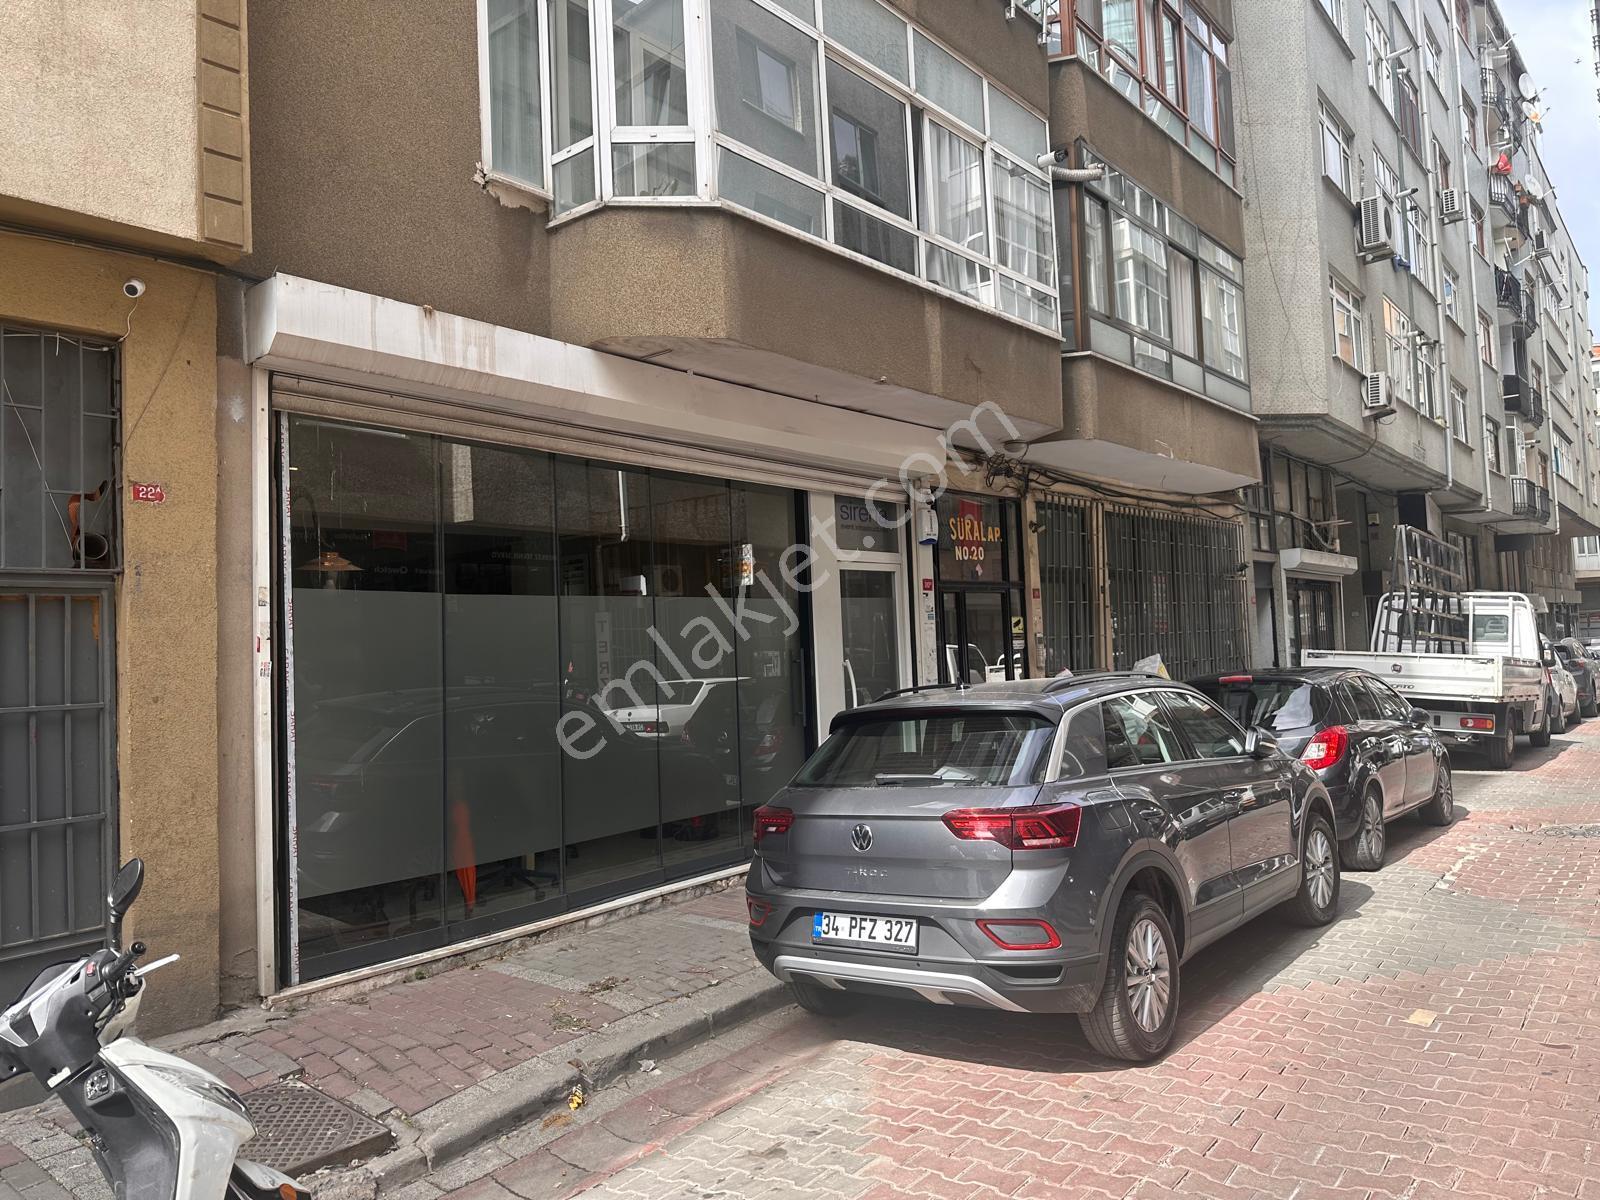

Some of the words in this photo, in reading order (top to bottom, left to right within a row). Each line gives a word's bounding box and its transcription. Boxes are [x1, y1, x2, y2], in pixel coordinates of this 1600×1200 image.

[954, 545, 985, 561] NO.20
[822, 914, 840, 937] 34
[848, 916, 878, 940] PFZ
[884, 919, 914, 943] 327
